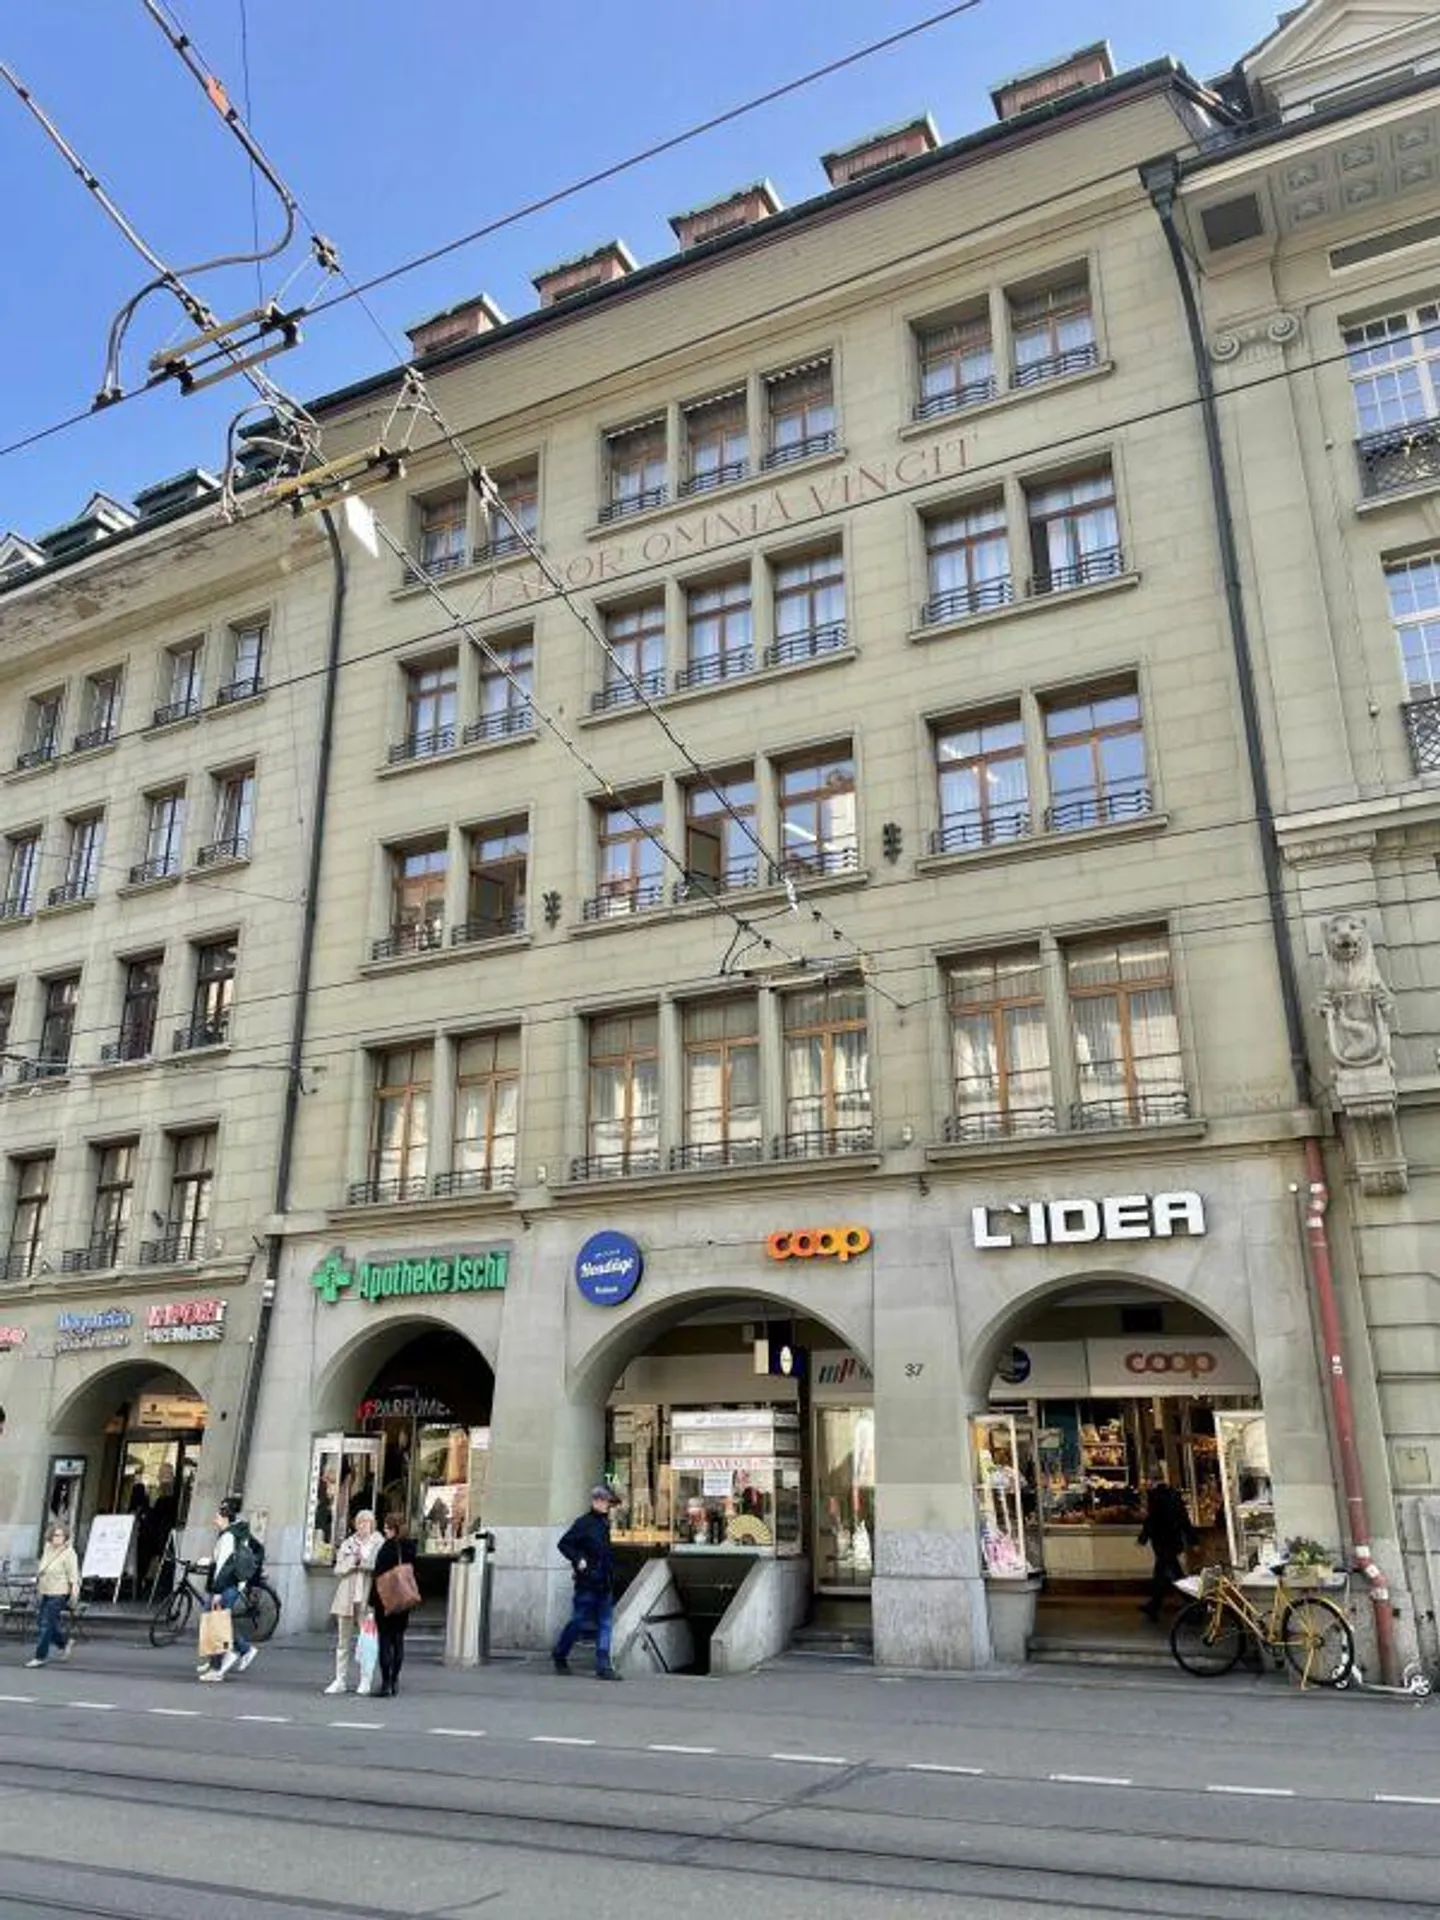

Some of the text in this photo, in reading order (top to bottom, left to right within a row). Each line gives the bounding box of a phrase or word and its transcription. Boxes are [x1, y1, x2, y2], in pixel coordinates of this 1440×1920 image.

[643, 490, 791, 563] OMNIA
[808, 437, 977, 517] VINCIT
[970, 1190, 1206, 1248] L'IDEA
[767, 1228, 871, 1262] coop
[360, 1258, 450, 1303] Apotheke
[905, 1363, 924, 1378] 37
[1125, 1351, 1217, 1379] coop
